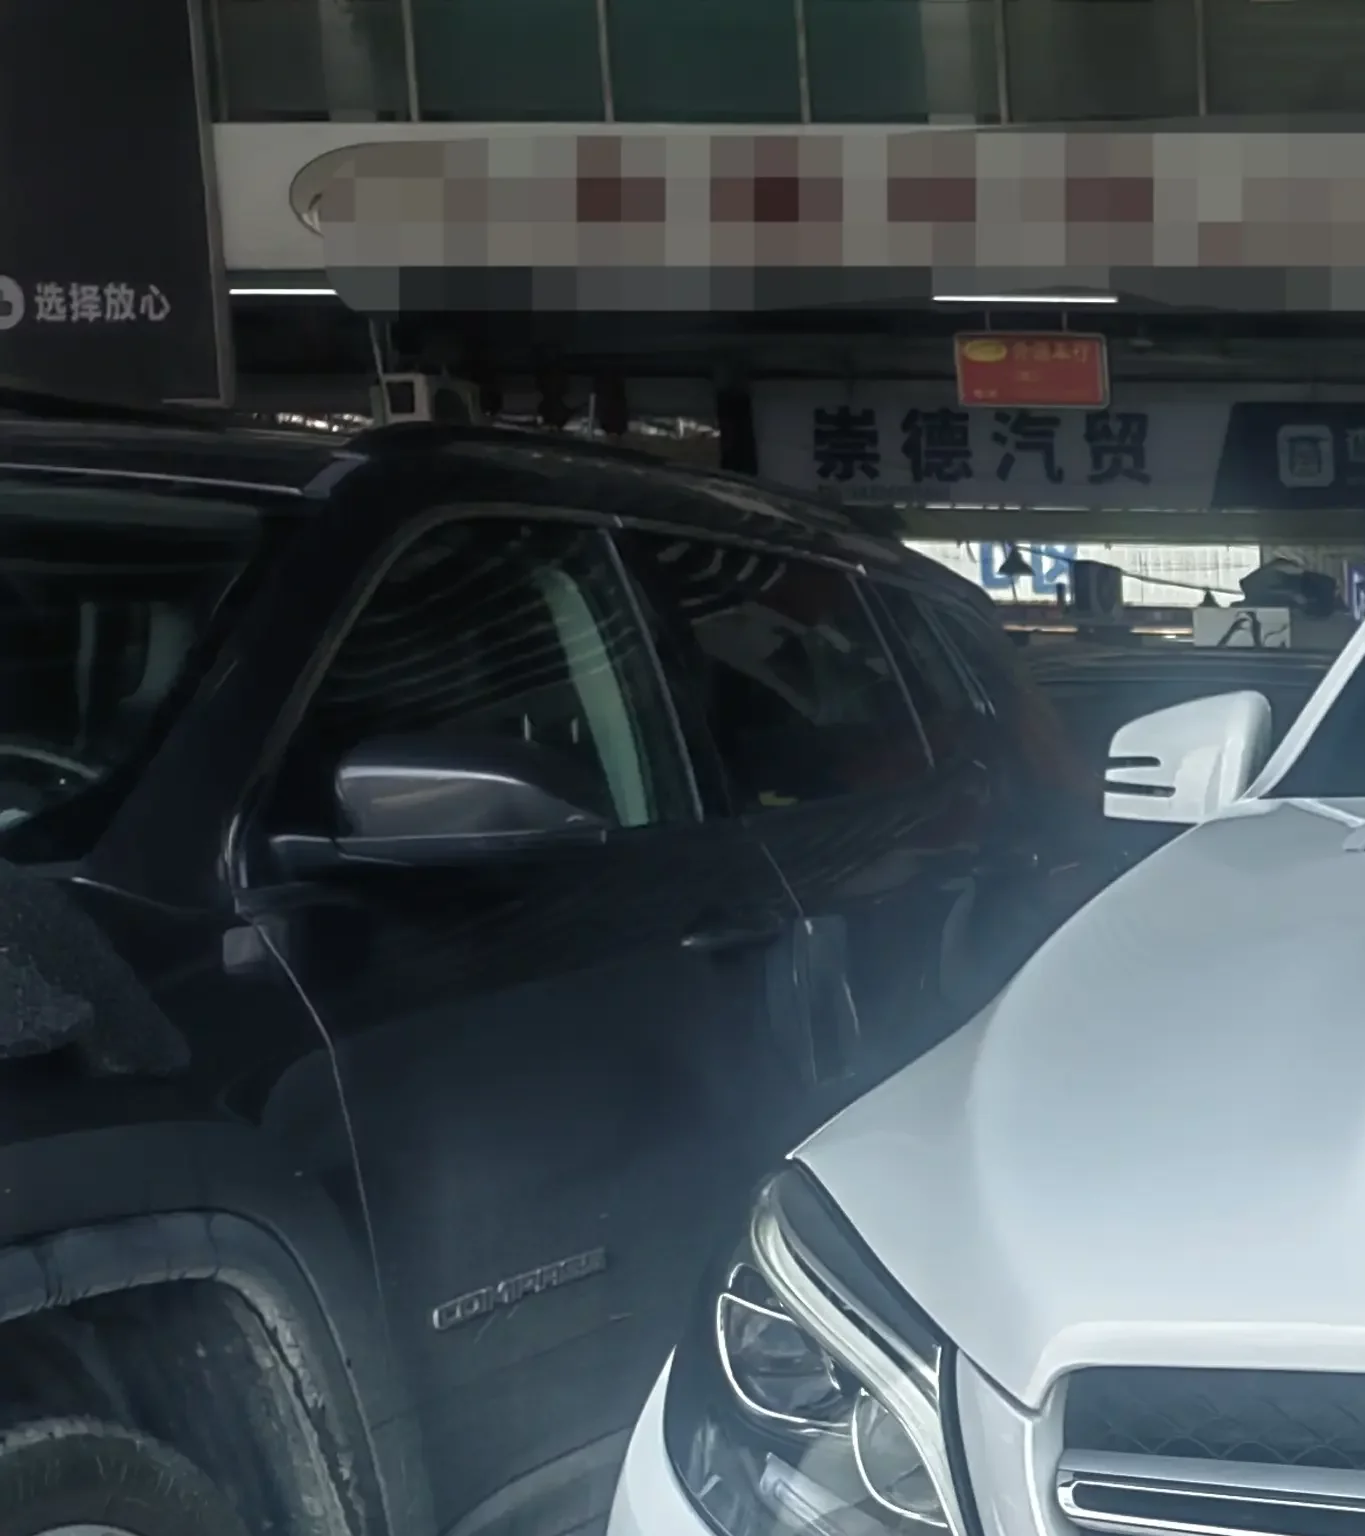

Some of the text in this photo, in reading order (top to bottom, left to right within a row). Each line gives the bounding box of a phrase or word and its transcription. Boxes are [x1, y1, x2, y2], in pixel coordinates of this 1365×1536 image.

[33, 281, 172, 324] 选择放心
[812, 405, 1153, 485] 崇德汽贸
